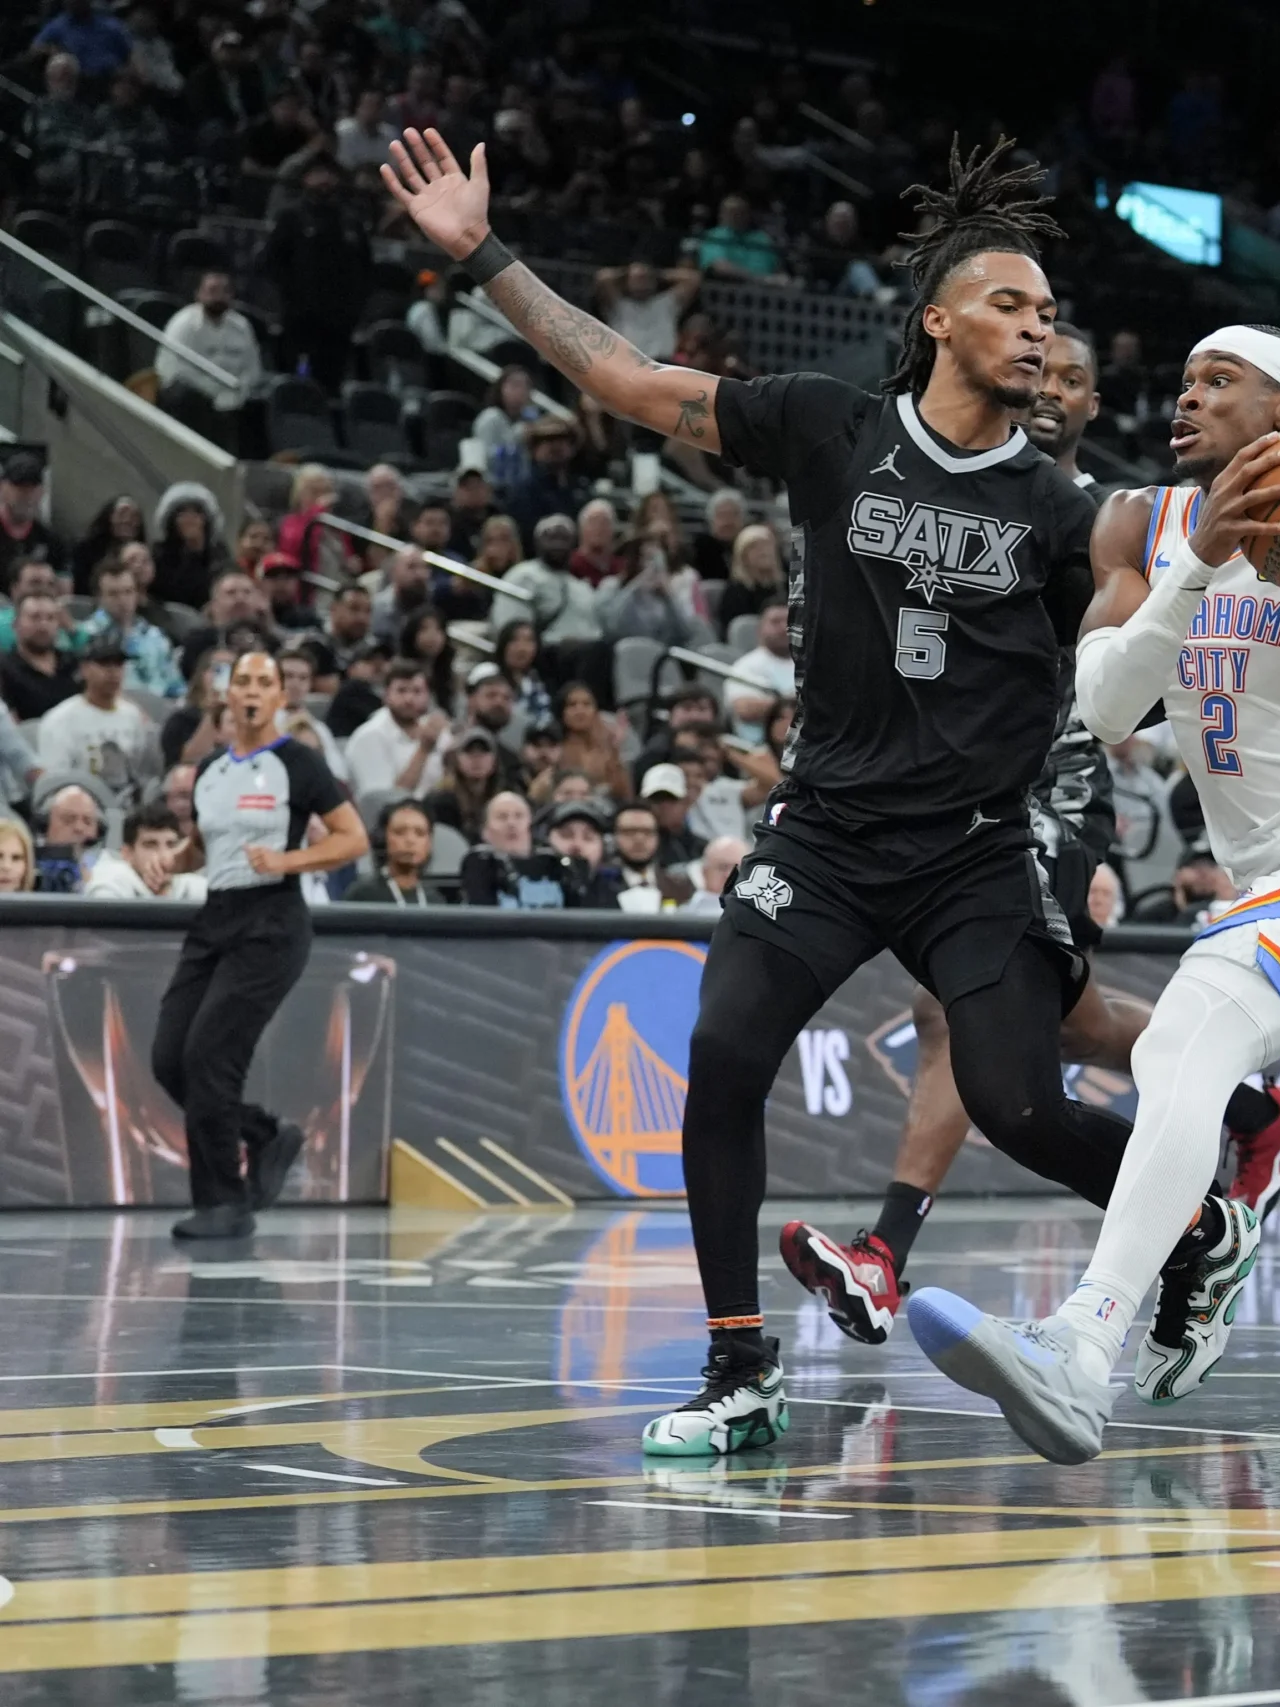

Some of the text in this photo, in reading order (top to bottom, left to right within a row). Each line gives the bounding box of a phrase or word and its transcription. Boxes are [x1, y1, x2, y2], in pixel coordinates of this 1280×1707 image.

[847, 491, 1032, 594] SATX
[895, 607, 950, 680] 5
[1177, 646, 1250, 693] CITY
[1200, 691, 1244, 777] 2
[797, 1029, 852, 1117] VS
